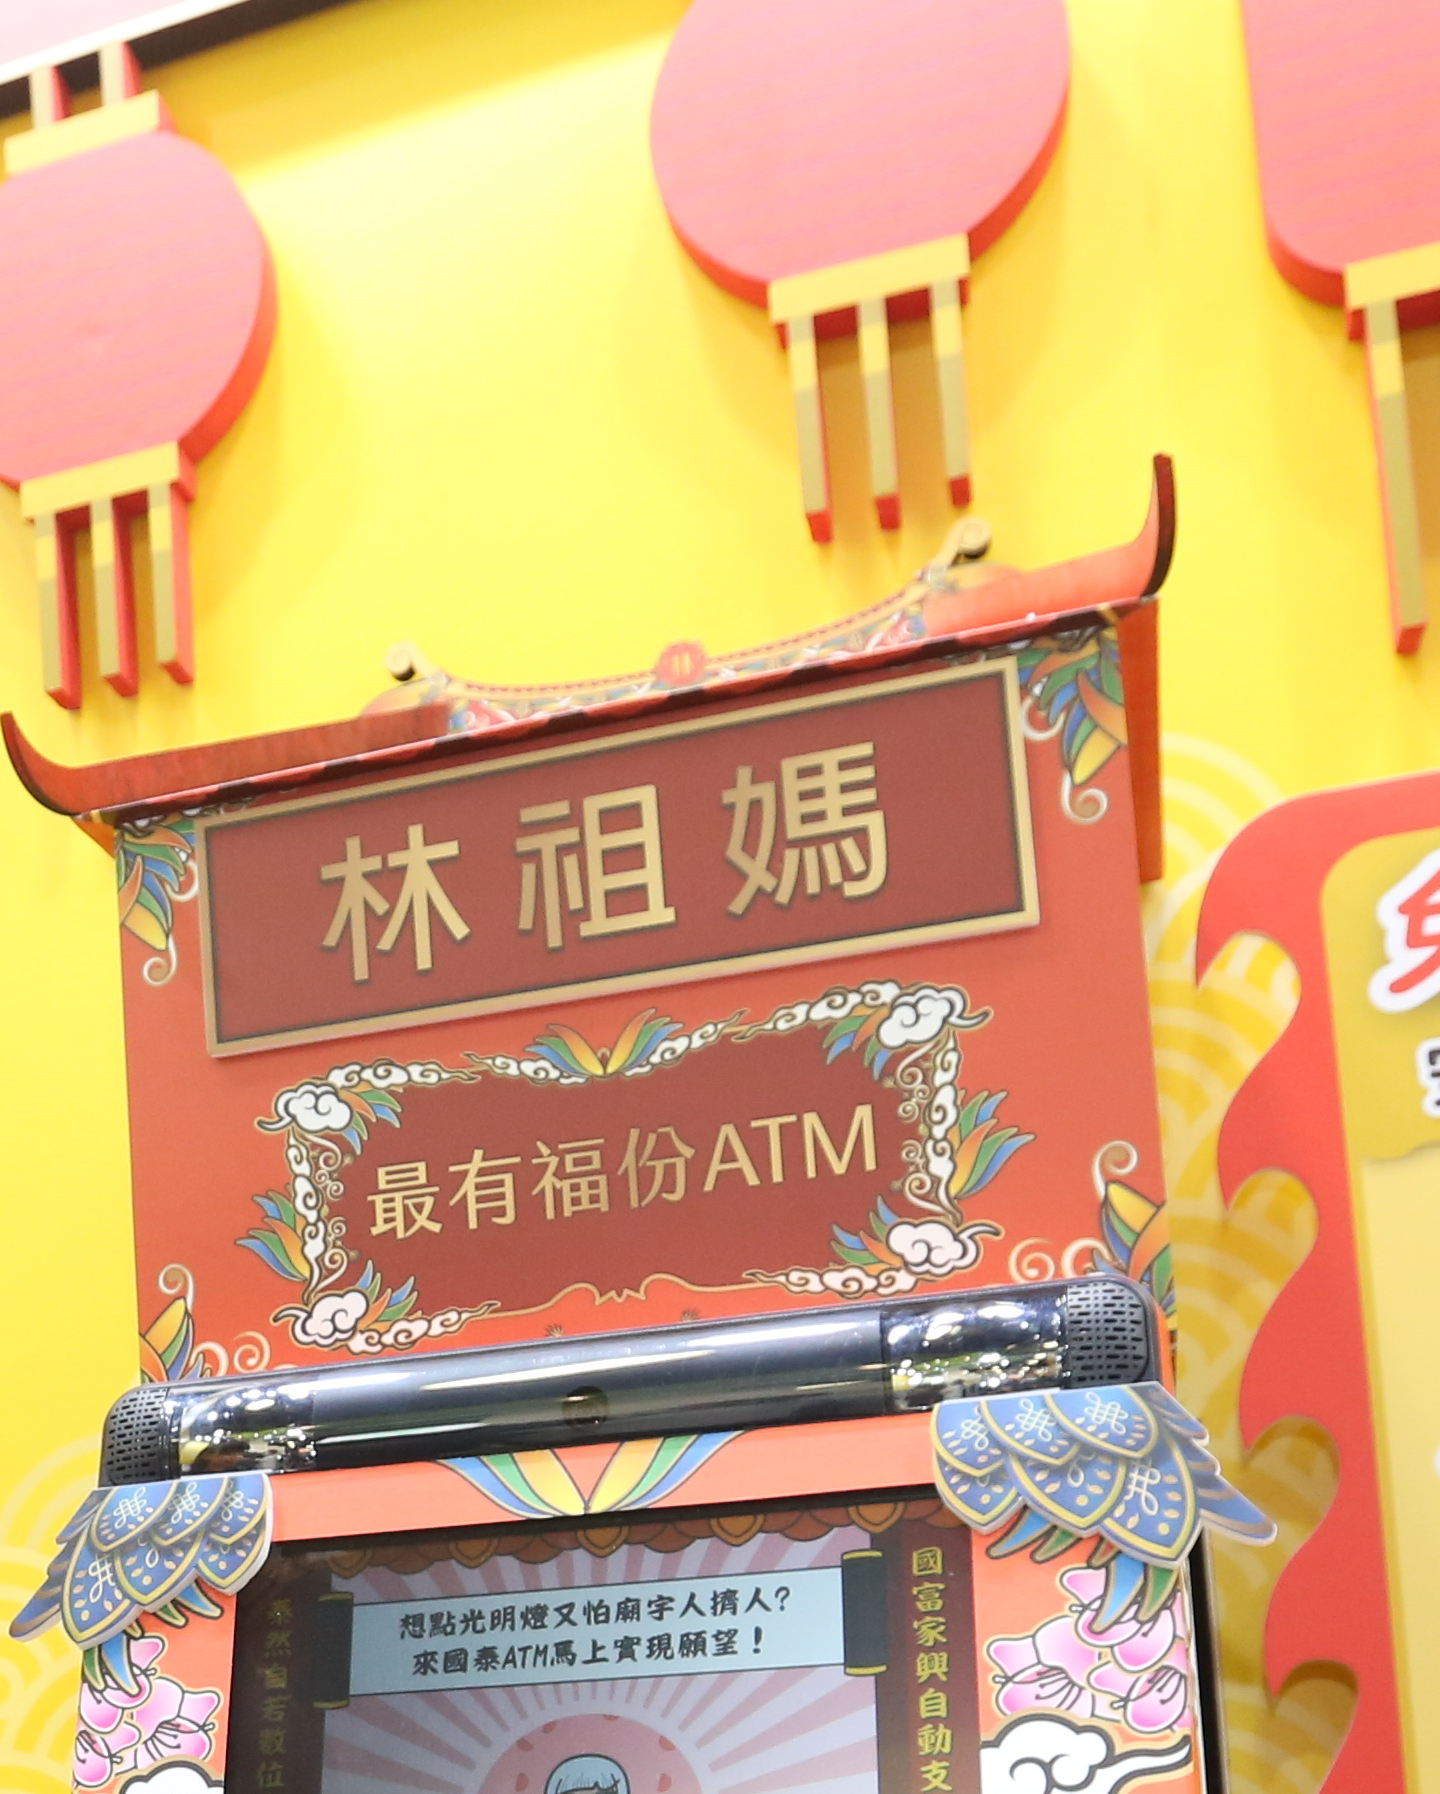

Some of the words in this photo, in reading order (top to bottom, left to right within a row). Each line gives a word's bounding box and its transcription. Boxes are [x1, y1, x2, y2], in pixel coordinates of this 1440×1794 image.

[320, 740, 889, 982] 林祖媽
[367, 1104, 879, 1241] 最有福份ATM
